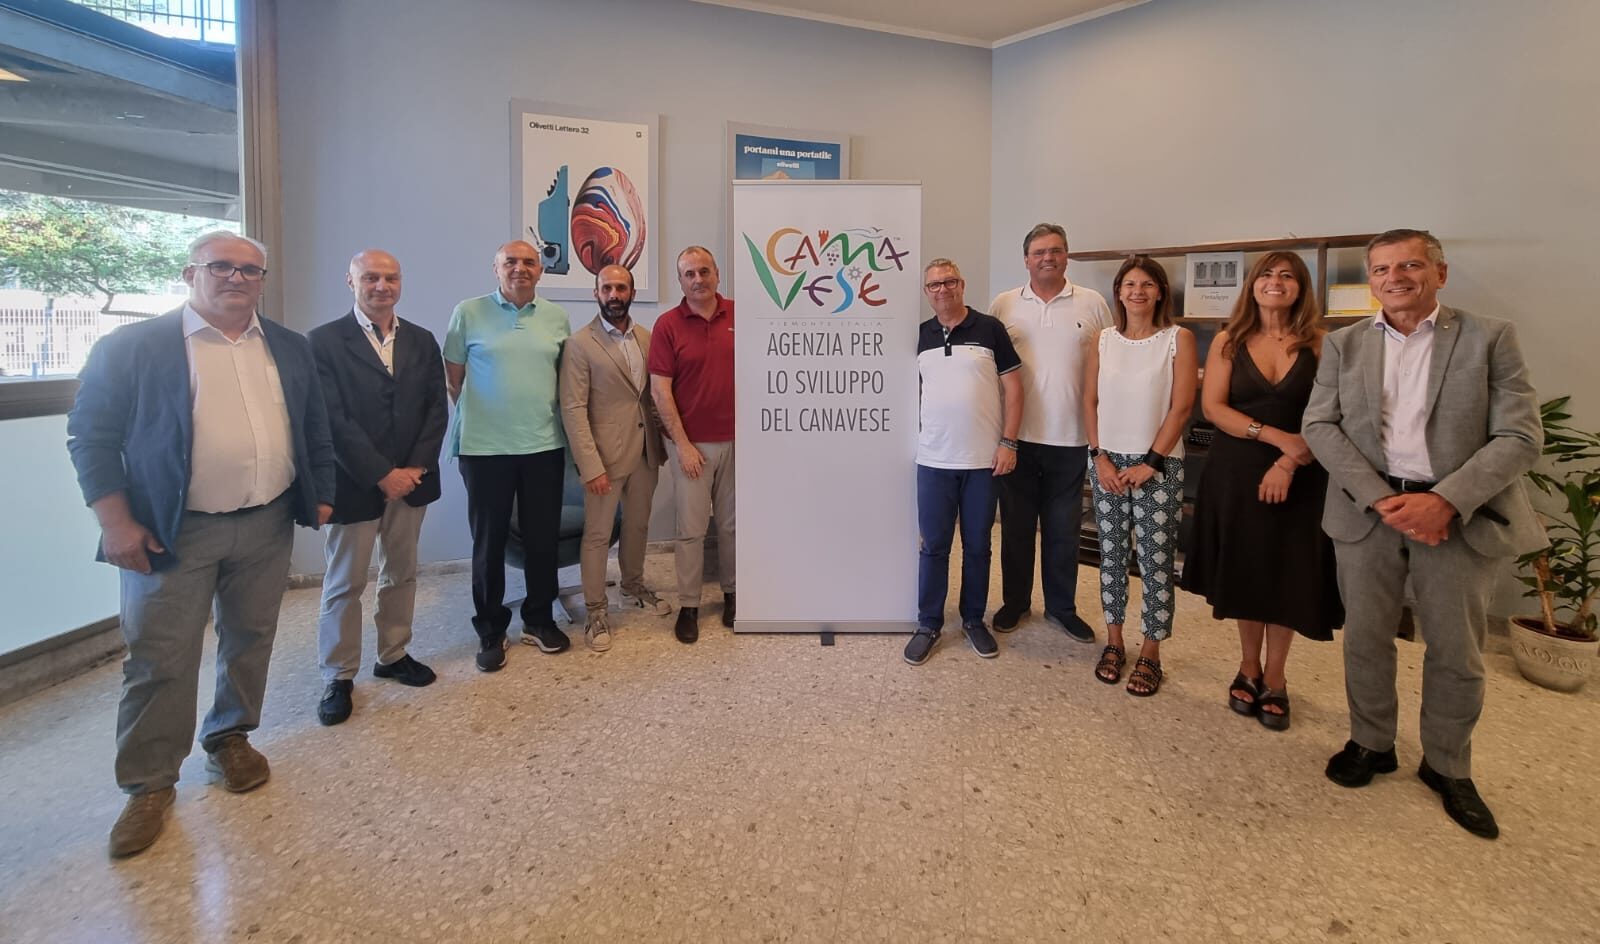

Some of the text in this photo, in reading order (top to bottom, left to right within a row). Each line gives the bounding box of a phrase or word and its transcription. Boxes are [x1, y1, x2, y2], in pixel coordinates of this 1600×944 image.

[529, 121, 554, 131] Olivetti
[555, 124, 580, 133] Lettera
[744, 145, 778, 155] portami
[797, 151, 832, 160] portatile
[767, 332, 883, 356] AGENZIA PER
[767, 370, 884, 394] LO SVILUPPO
[761, 408, 890, 432] DEL CANAVESE
